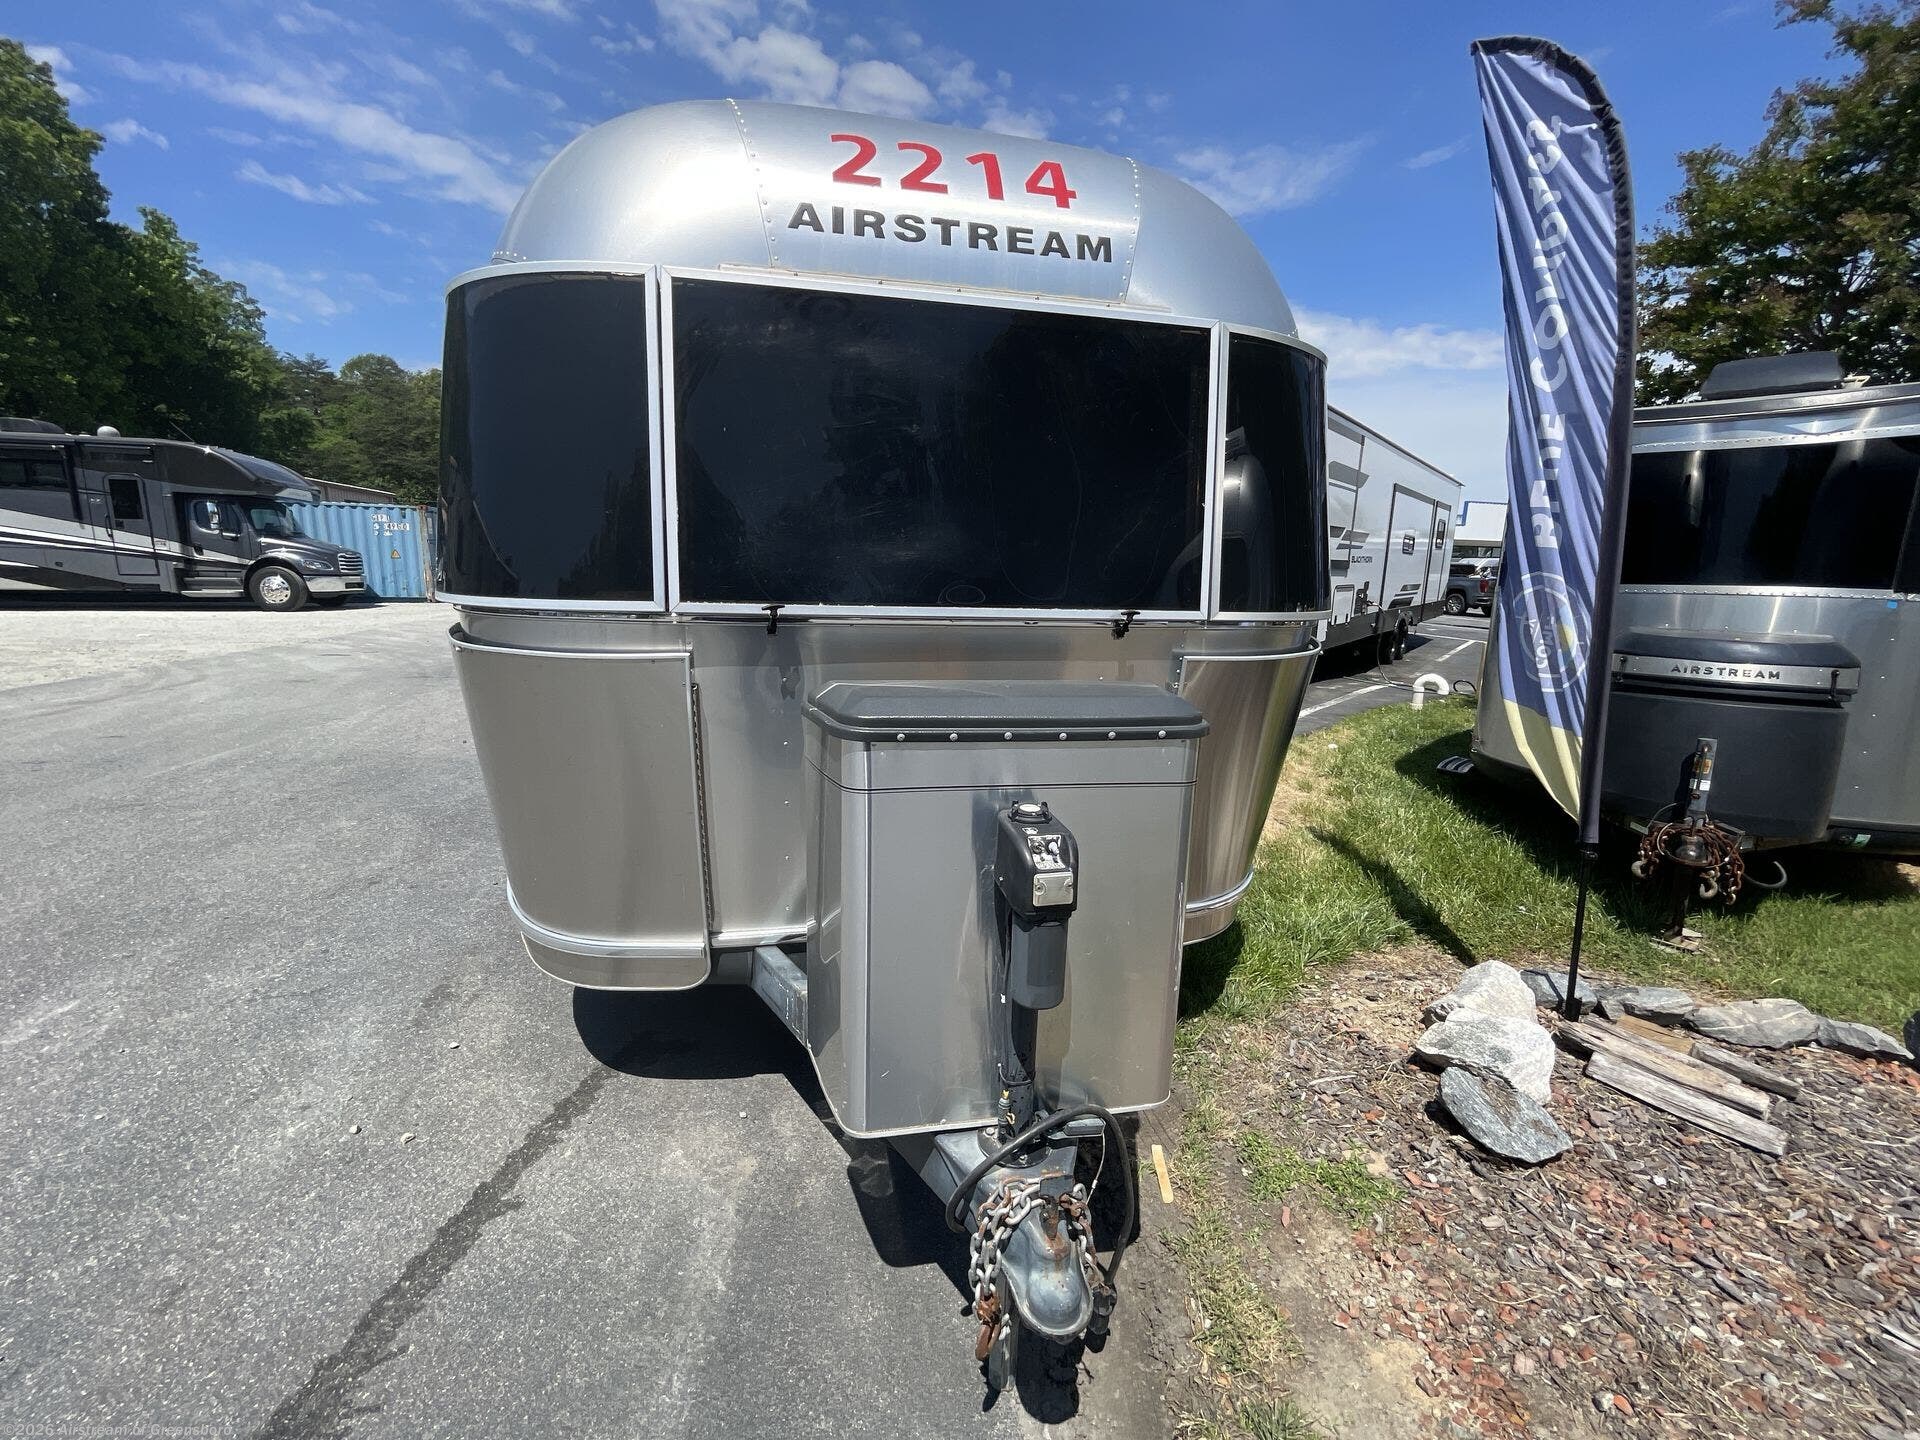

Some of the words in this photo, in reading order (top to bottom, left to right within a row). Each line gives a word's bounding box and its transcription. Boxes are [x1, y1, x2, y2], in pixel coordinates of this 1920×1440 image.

[829, 132, 1078, 210] 2214
[787, 202, 1113, 263] AIRSTREAM
[1671, 664, 1780, 680] AIRSTREAM
